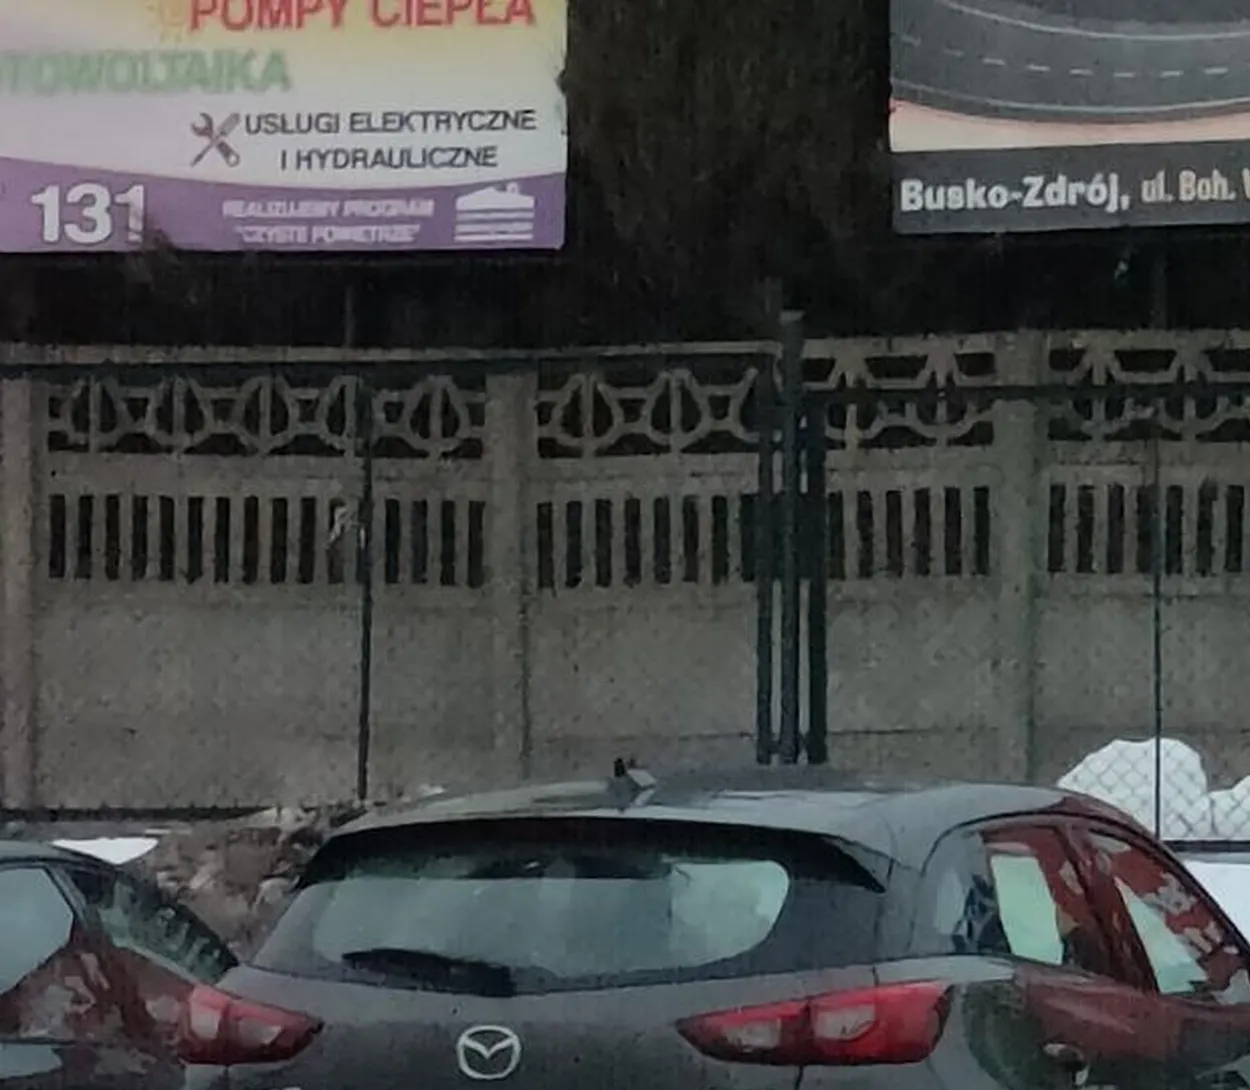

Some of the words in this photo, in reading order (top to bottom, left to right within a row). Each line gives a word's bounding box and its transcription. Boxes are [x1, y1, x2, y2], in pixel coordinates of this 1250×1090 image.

[188, 0, 346, 31] POMPY
[349, 109, 537, 133] ELEKTRYCZNE
[281, 151, 287, 171] I
[296, 146, 498, 171] HYDRAULICZNE
[900, 172, 1131, 214] Busko-Zdrój,
[1141, 172, 1173, 203] ul.
[1179, 170, 1236, 201] Boh.
[31, 183, 145, 244] 131
